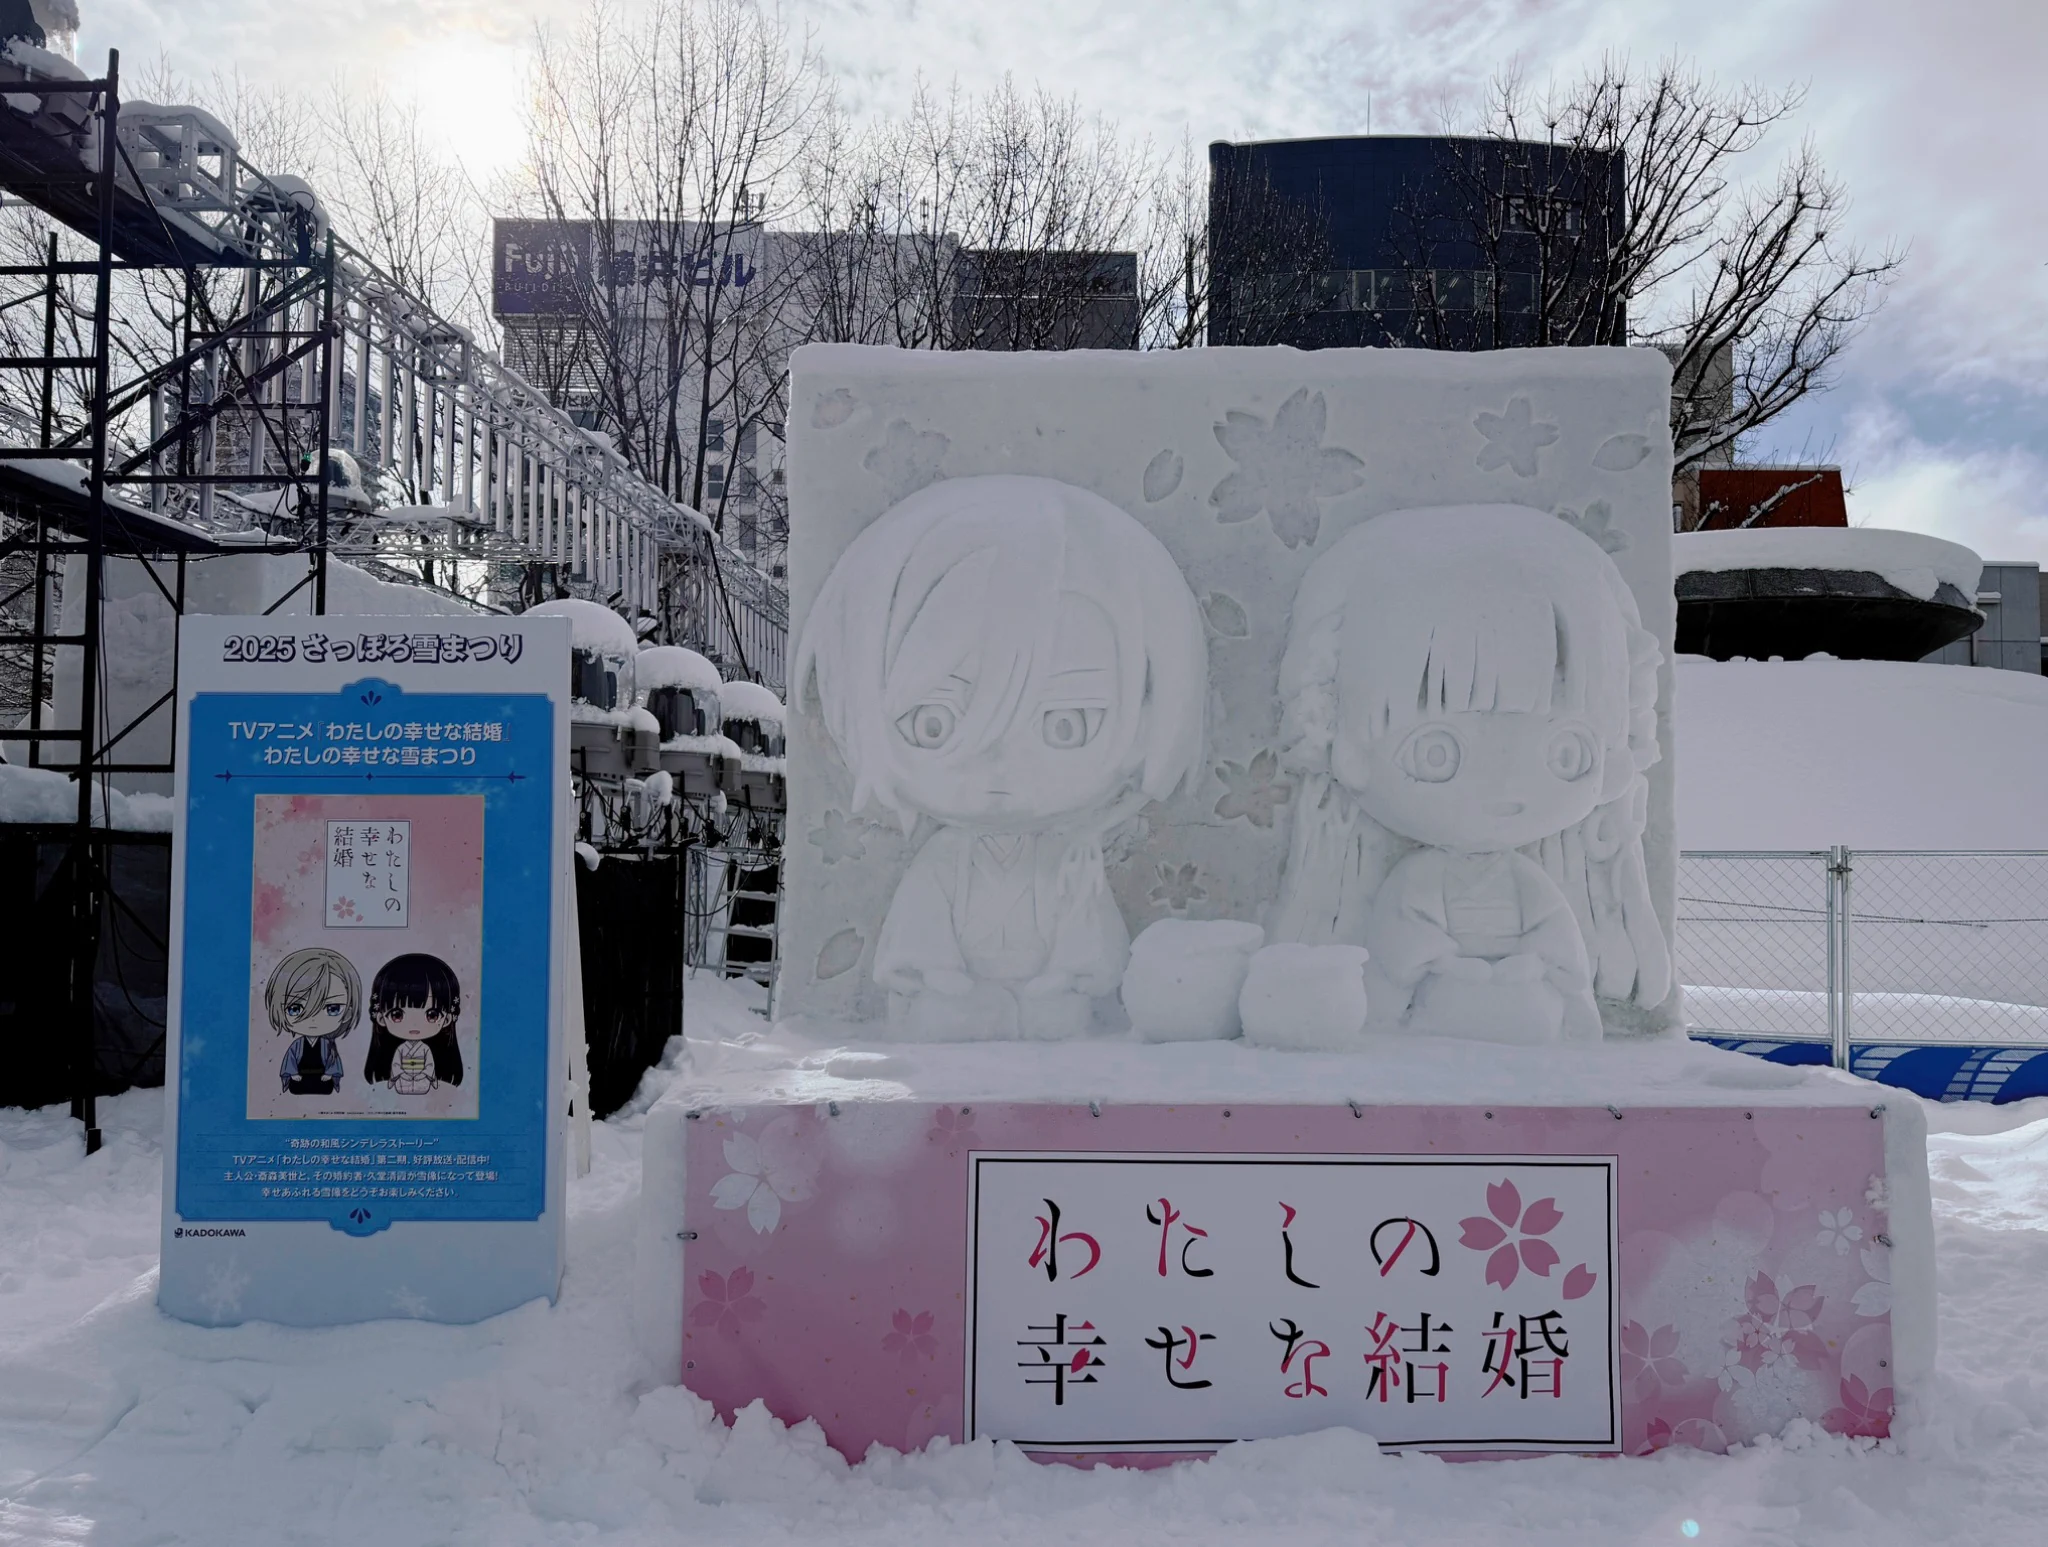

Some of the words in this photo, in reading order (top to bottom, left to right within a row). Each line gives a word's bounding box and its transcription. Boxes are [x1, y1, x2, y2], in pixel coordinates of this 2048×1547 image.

[223, 635, 296, 663] 2025
[302, 633, 523, 664] さっぽろ雪まつり
[228, 722, 512, 742] TVアニメ『わたしの幸せな結婚』
[264, 746, 477, 766] わたしの幸せな雪まつり
[333, 826, 354, 868] 結婚
[360, 826, 380, 889] 幸せな
[384, 826, 403, 912] わたしの
[185, 1228, 246, 1238] KADOKAWA
[1029, 1198, 1440, 1288] わたしの
[1017, 1310, 1569, 1406] 幸せな結婚
